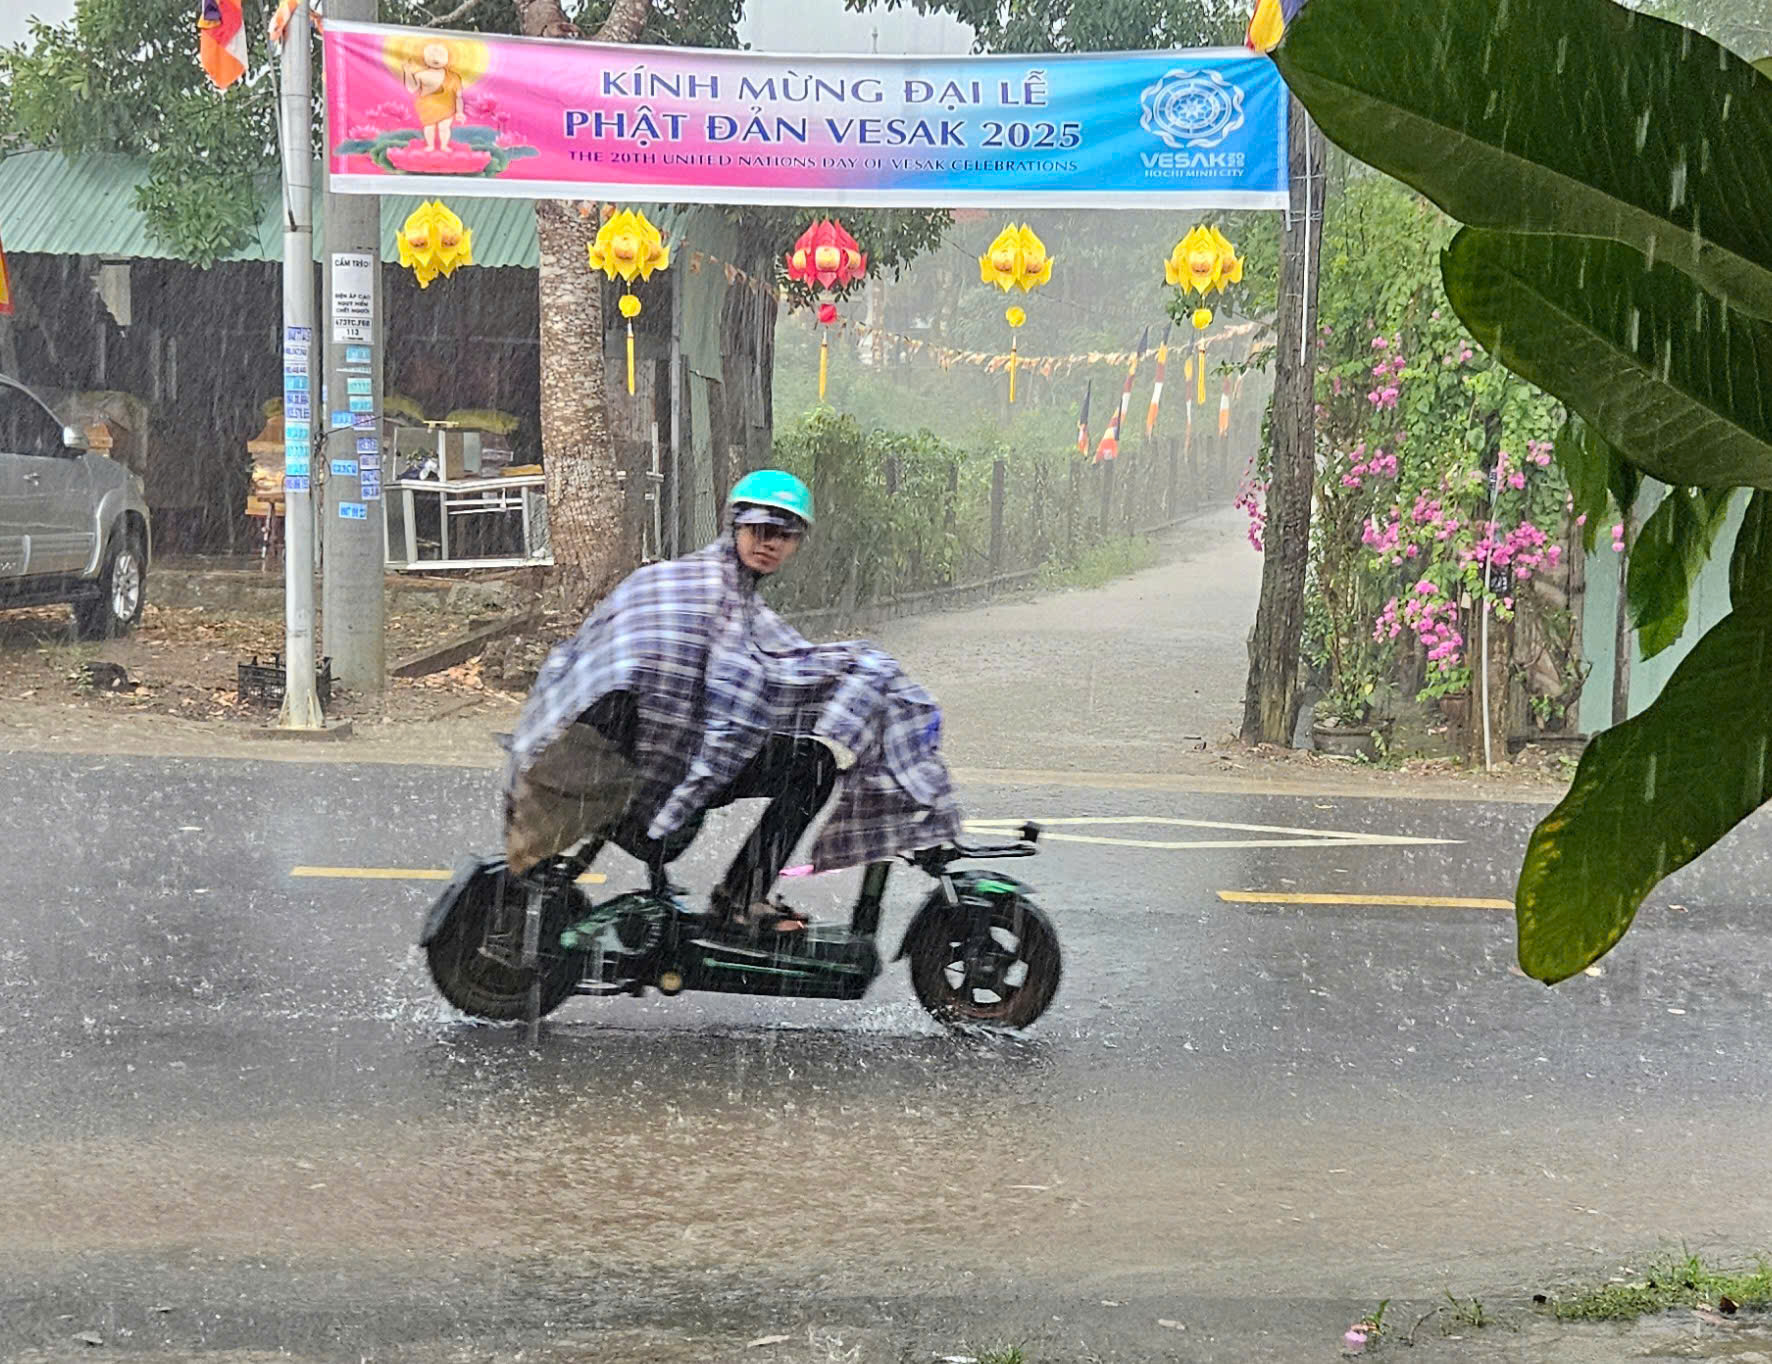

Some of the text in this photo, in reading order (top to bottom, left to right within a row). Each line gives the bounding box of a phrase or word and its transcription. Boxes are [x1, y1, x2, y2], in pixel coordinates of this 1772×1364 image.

[603, 65, 1046, 111] KÍNH MỪNG ĐẠI LỄ
[565, 104, 1081, 148] PHẬT ĐẢN VESAK 2025
[568, 151, 1078, 172] THE 20TH UNITED NATIONS DAY OF VESAK CELEBRATIONS
[1140, 152, 1226, 168] VESAK
[1218, 169, 1244, 177] CITY
